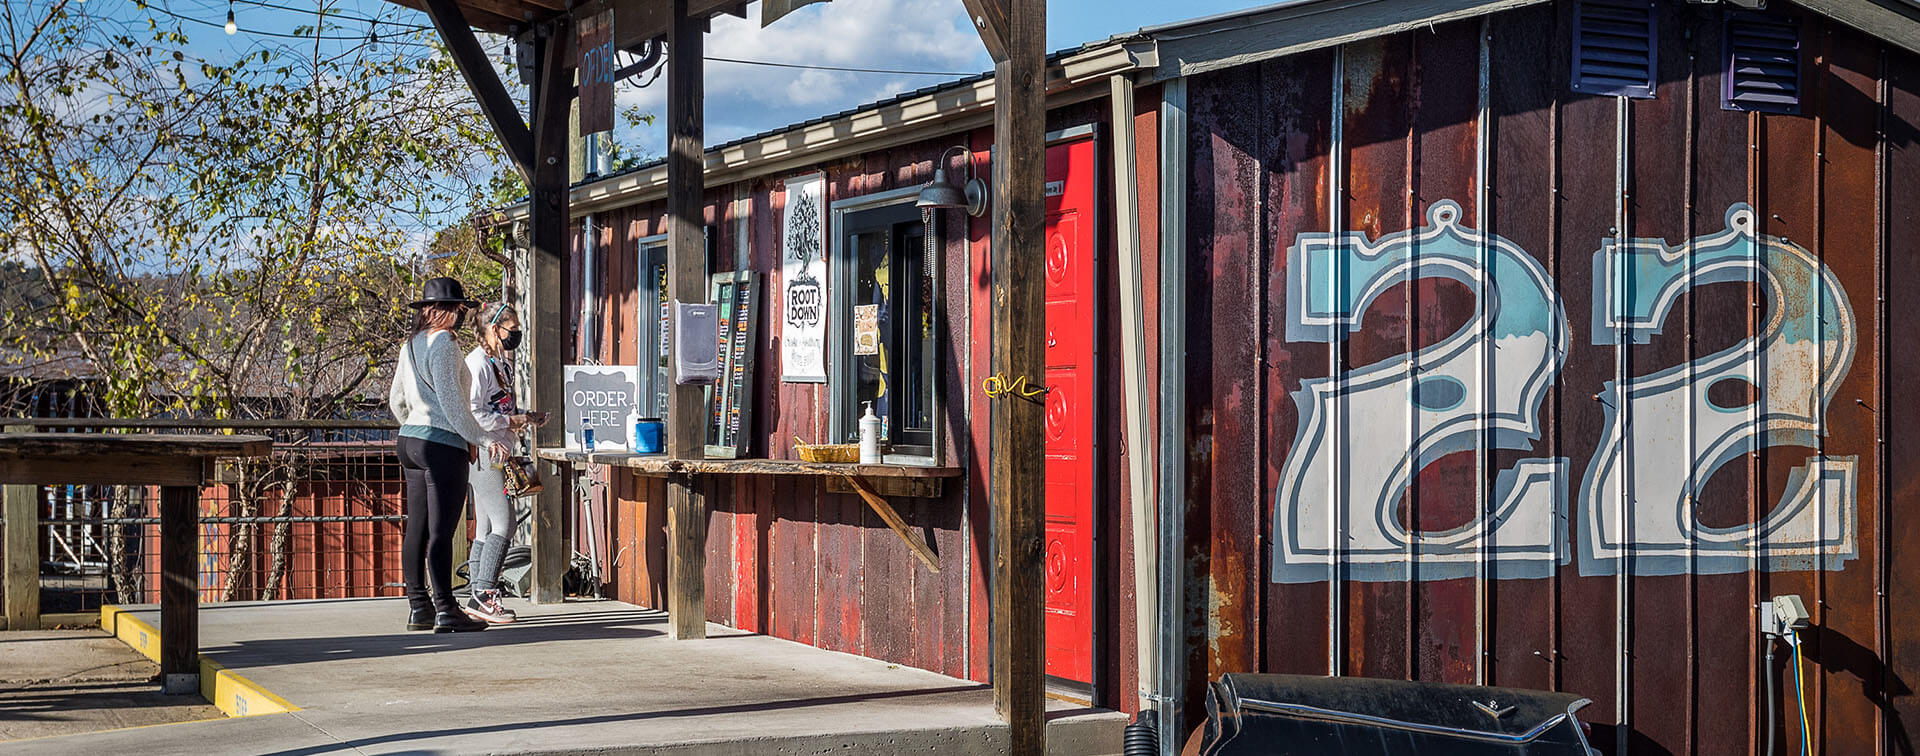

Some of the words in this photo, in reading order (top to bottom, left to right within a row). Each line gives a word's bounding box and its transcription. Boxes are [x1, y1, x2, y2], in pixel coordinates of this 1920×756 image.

[791, 289, 816, 305] ROOT
[791, 306, 816, 320] DOWN
[573, 390, 627, 407] ORDER
[1272, 199, 1858, 583] 22
[580, 410, 620, 427] HERE
